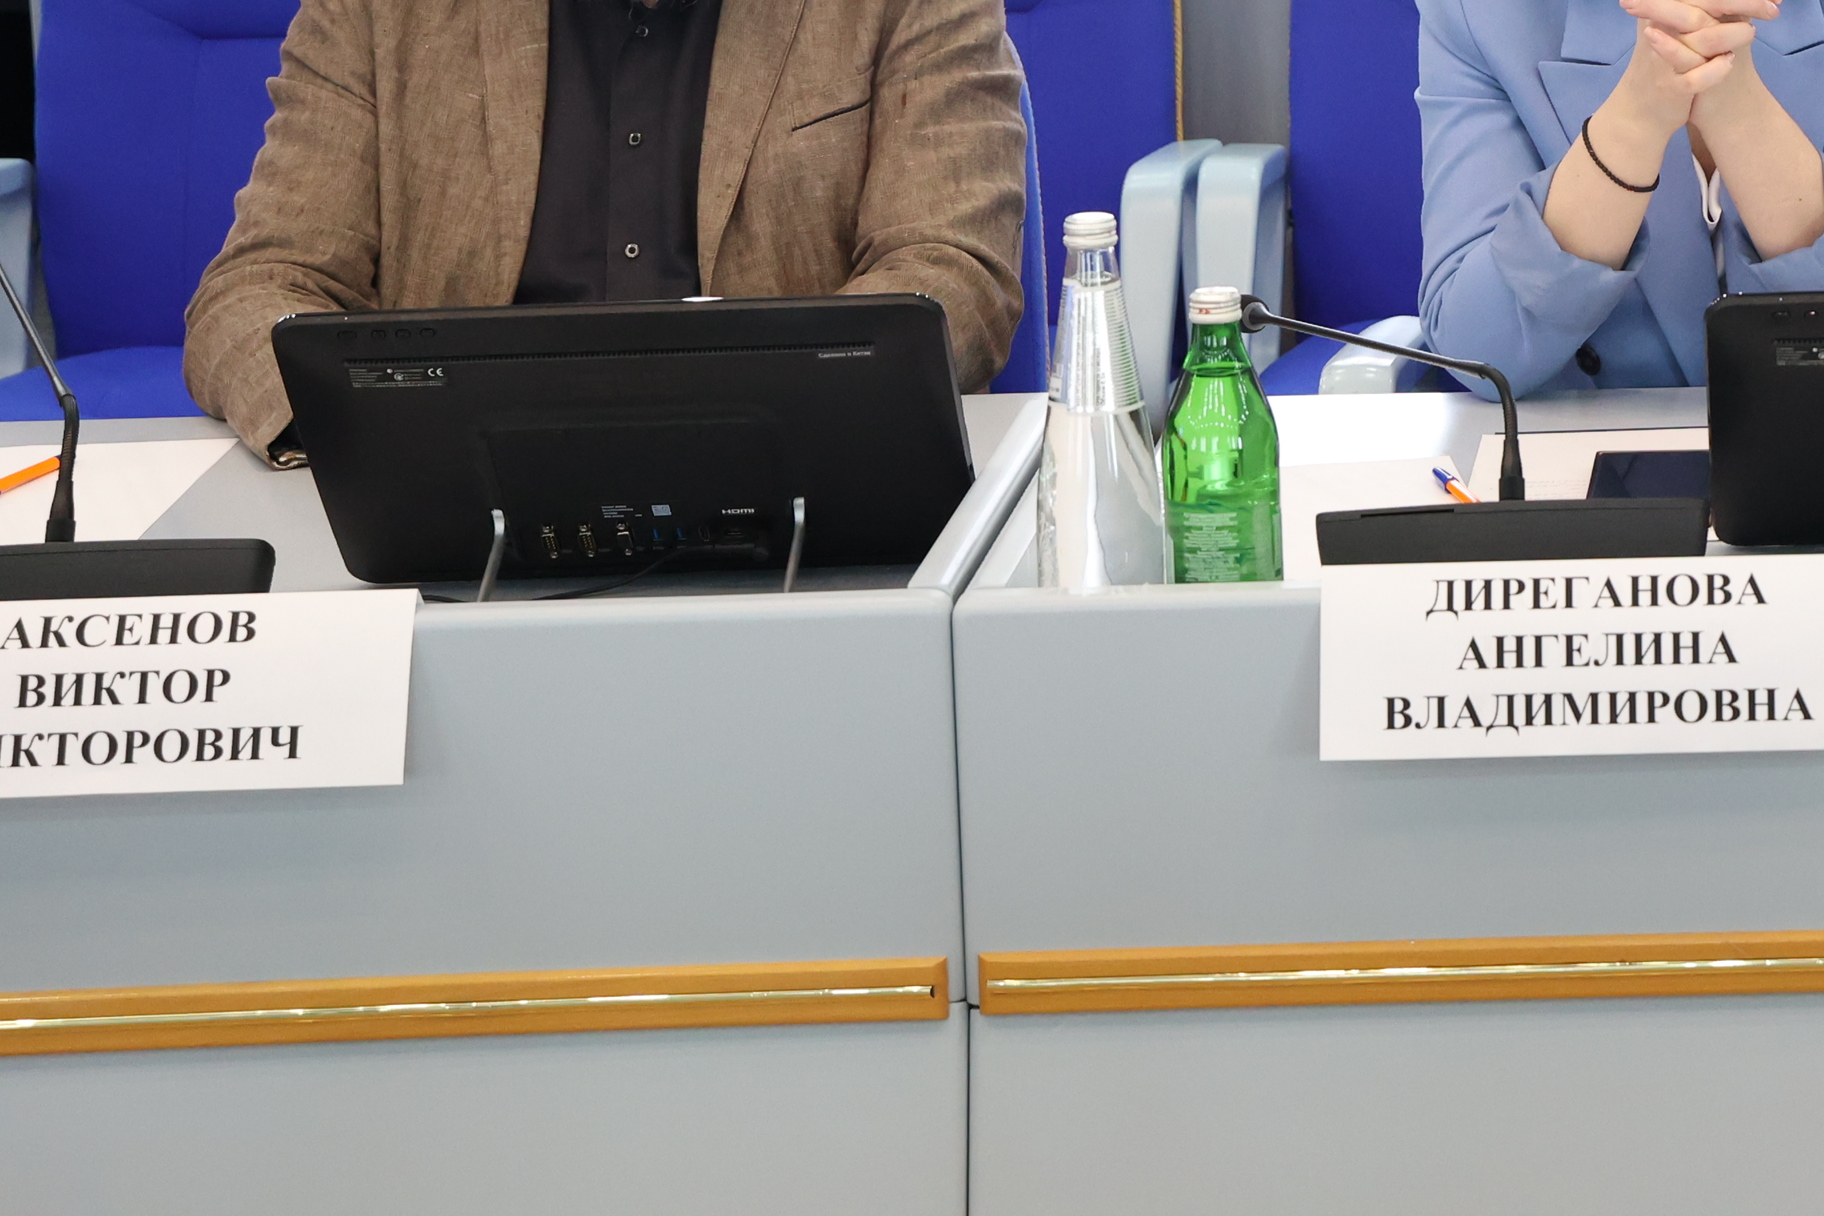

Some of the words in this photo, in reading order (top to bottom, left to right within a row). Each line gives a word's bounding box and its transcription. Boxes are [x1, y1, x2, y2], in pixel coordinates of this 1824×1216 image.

[1426, 574, 1767, 620] ДИРЕГАНОВА
[0, 611, 256, 649] АКСЕНОВ
[1457, 631, 1738, 670] АНГЕЛИНА
[14, 669, 231, 708] ВИКТОР
[1386, 688, 1814, 736] ВЛАДИМИРОВНА
[0, 725, 302, 768] КТОРОВИЧ
